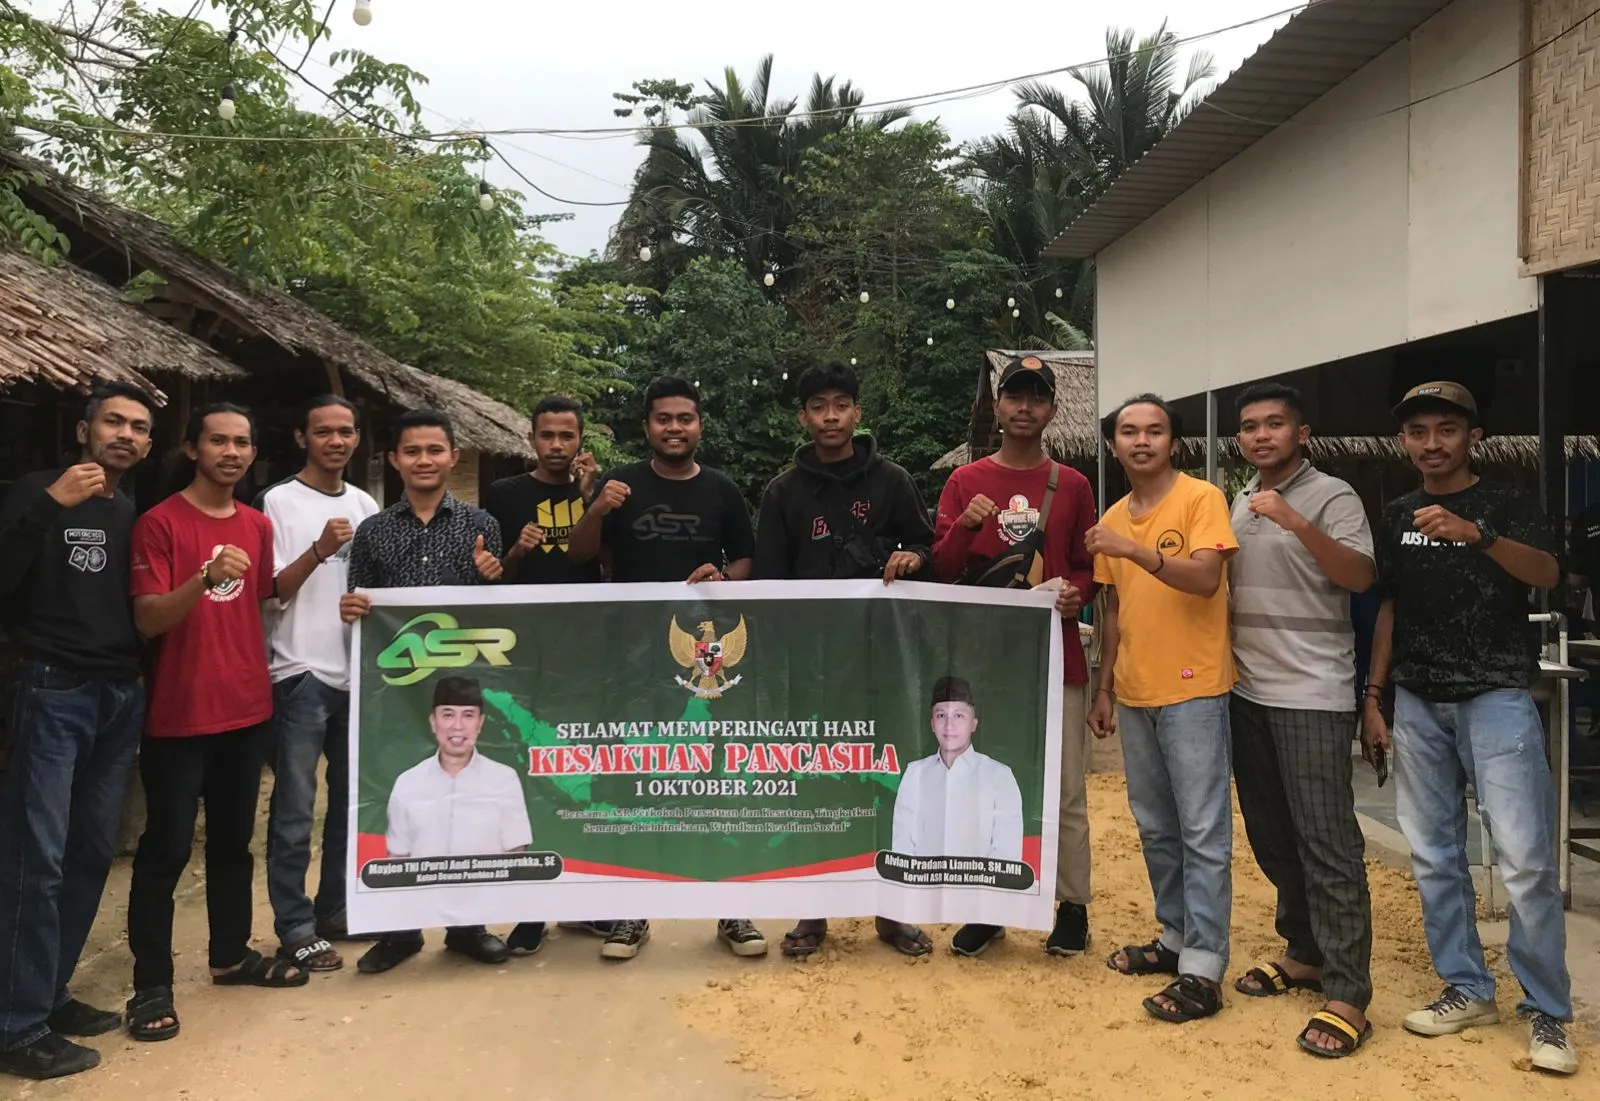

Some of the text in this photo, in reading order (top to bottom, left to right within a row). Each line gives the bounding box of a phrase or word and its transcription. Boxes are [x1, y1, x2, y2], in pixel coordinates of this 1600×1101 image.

[632, 511, 701, 536] ASR
[1400, 531, 1429, 546] JUST
[377, 620, 517, 676] ASR
[557, 719, 875, 740] SELAMAT MEMPERINGATI HARI
[528, 742, 901, 776] KESAKTIAN PANCASILA
[635, 778, 798, 796] 1 OKTOBER 2021
[632, 807, 683, 819] Perkokoh
[684, 807, 740, 818] Persatuan
[740, 807, 761, 818] dan
[815, 806, 877, 820] Tingkatkan
[583, 823, 636, 835] Semangat
[711, 822, 763, 834] Wujudkan
[764, 822, 813, 832] Keadilan
[368, 863, 403, 875] Mayjen
[404, 861, 419, 873] TNI
[421, 860, 448, 872] (Purn)
[449, 859, 470, 870] Andi
[544, 856, 556, 866] SE
[885, 854, 909, 869] Alvian
[910, 858, 948, 870] Pradana
[949, 859, 986, 872] Liambo,
[416, 869, 509, 882] Ketua Dewan Pembina ASR
[903, 871, 929, 882] Korwil
[944, 873, 963, 882] Kota
[963, 873, 996, 884] Kendari
